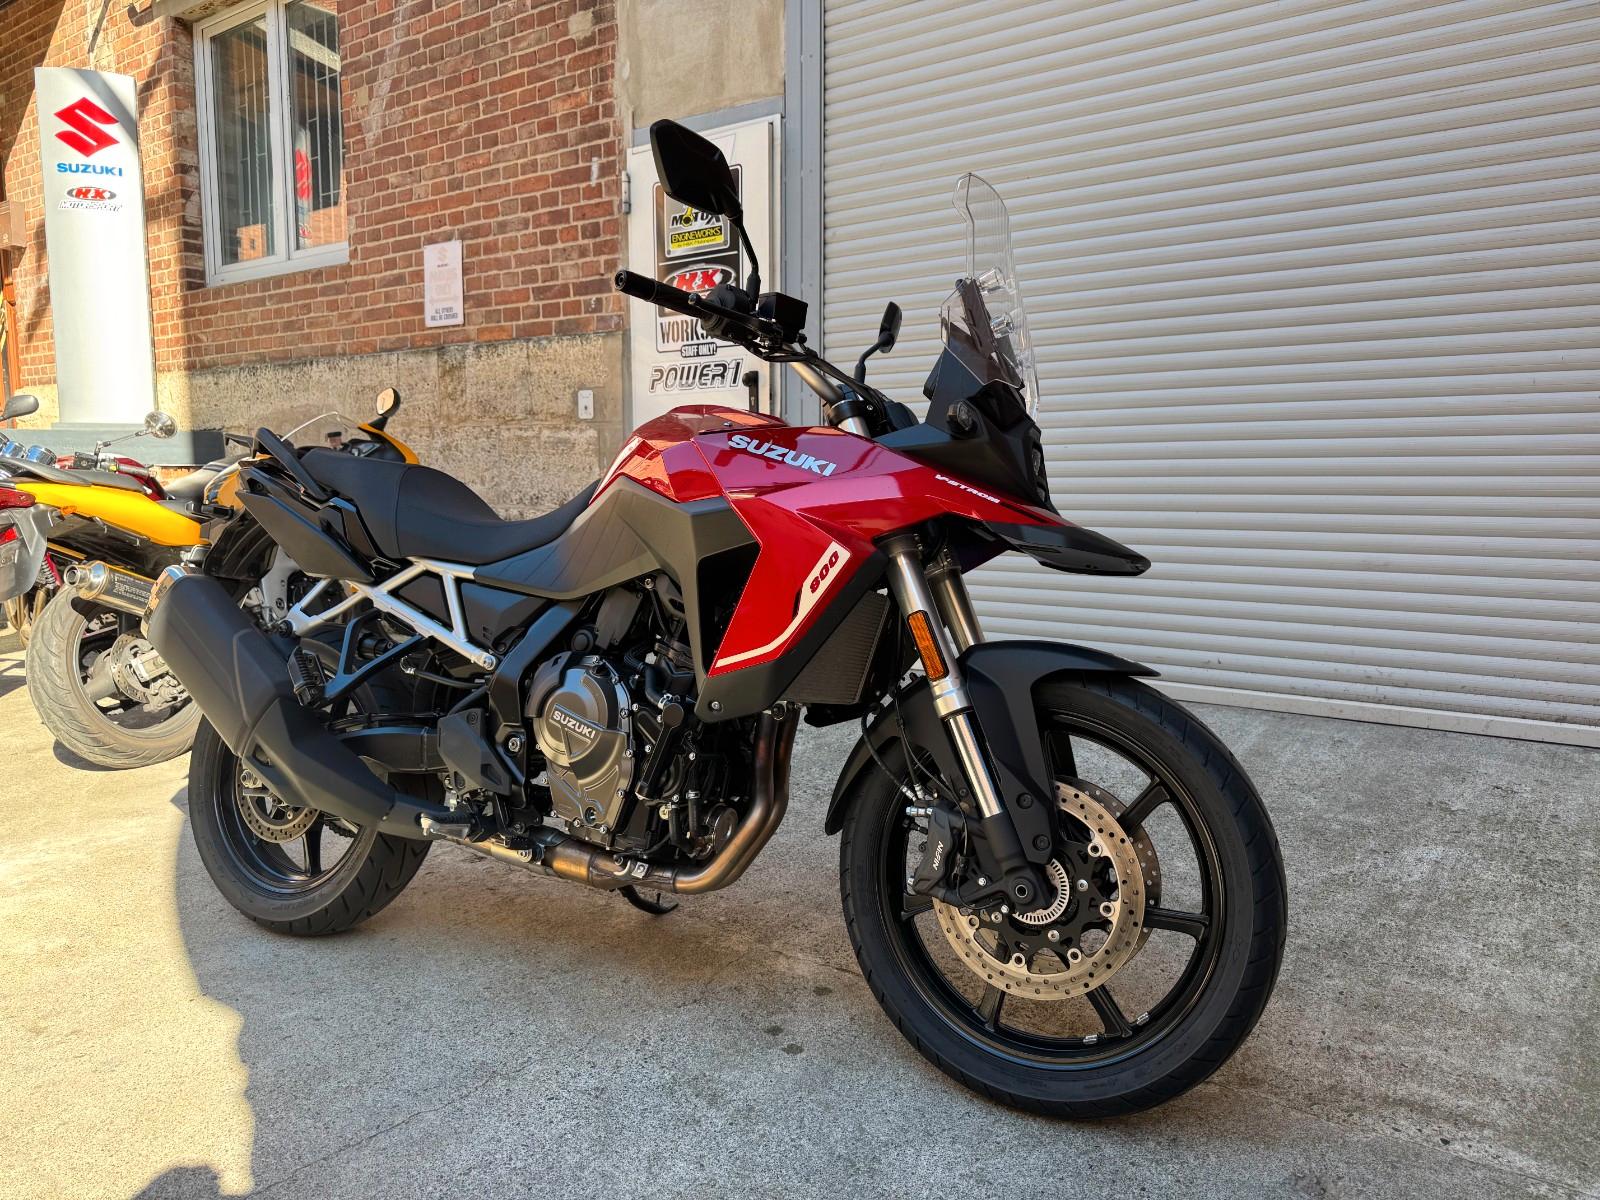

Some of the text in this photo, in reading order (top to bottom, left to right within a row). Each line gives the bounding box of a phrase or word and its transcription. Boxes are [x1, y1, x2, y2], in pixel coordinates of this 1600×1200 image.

[57, 163, 122, 177] SUZUKI
[682, 345, 698, 357] STAFF
[728, 434, 836, 477] SUZUKI
[810, 551, 839, 593] 800
[553, 711, 596, 739] SUZUKI
